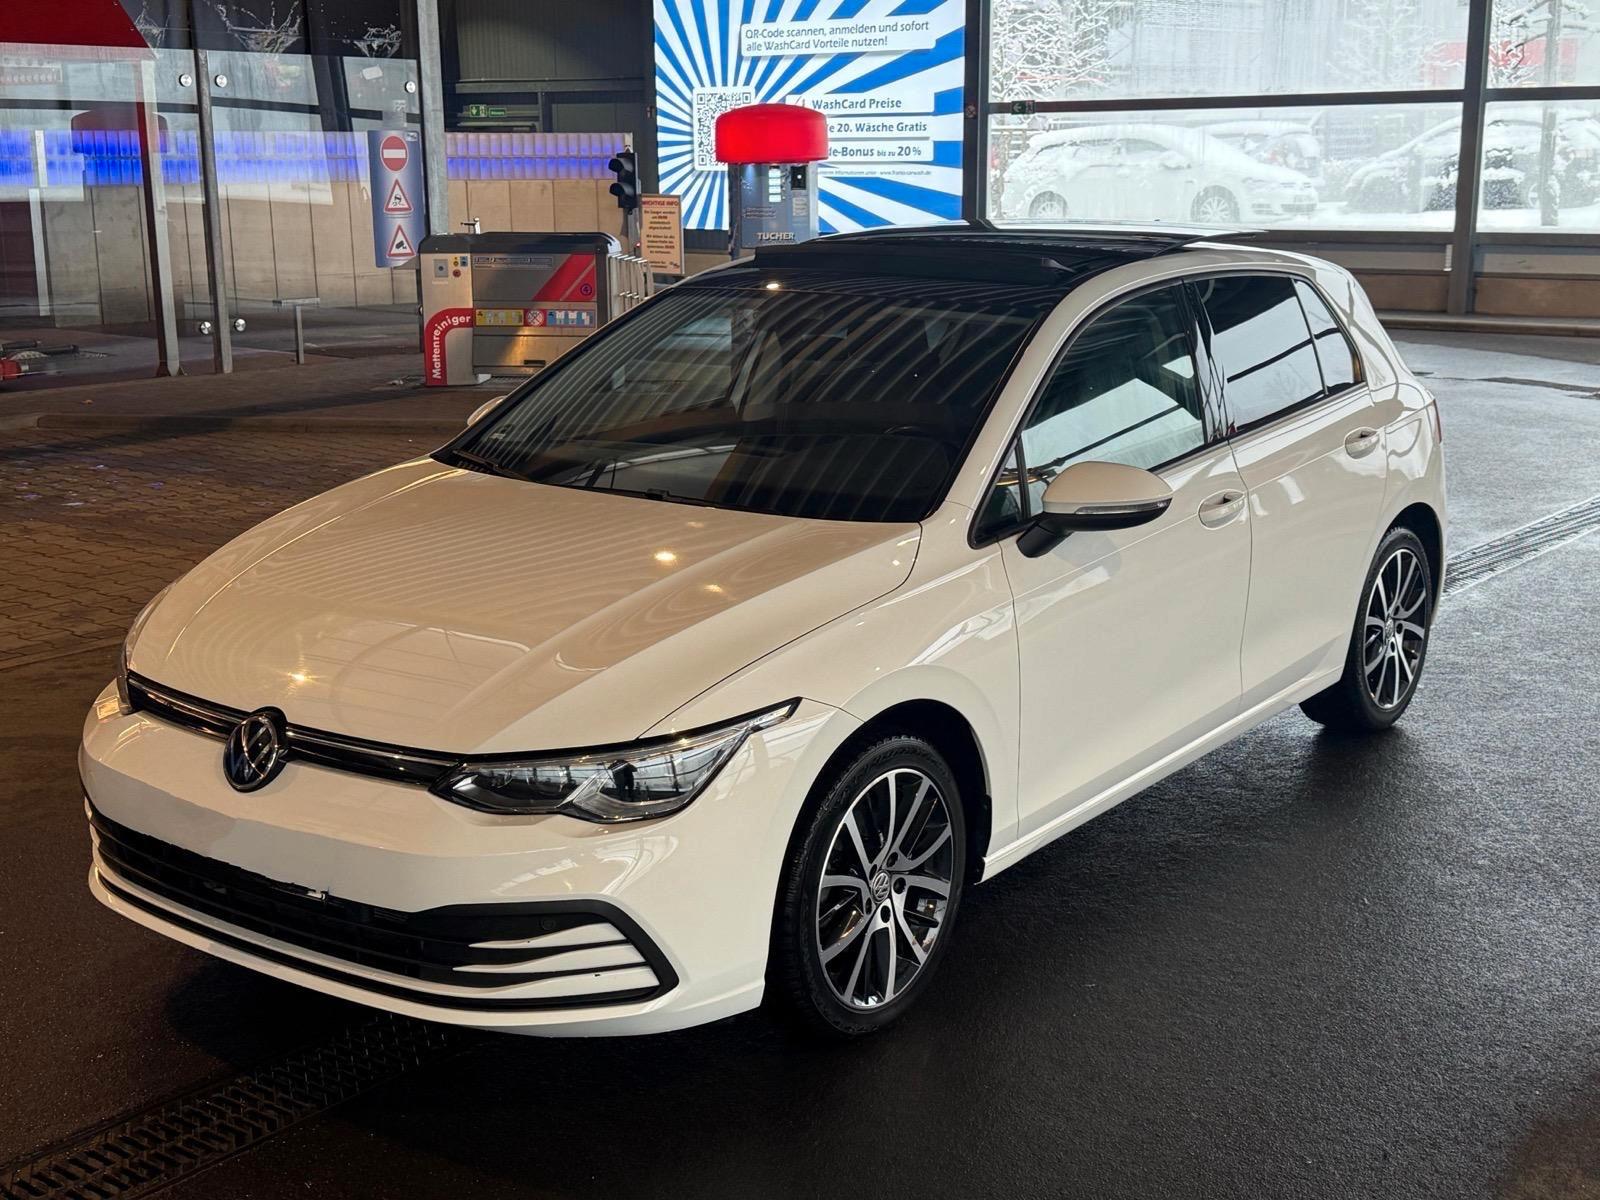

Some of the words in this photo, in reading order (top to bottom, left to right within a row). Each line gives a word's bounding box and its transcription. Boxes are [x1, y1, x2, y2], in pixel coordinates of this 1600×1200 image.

[745, 28, 784, 39] QR-Code
[786, 28, 826, 38] scannen,
[828, 24, 877, 35] anmelden
[878, 22, 898, 32] und
[899, 21, 929, 31] sofort
[746, 41, 762, 52] alle
[763, 39, 811, 51] WashCard
[812, 37, 849, 49] Vorteile
[851, 36, 888, 47] nutzen!
[812, 98, 867, 110] WashCard
[869, 97, 902, 109] Preise
[837, 123, 853, 133] 20.
[855, 122, 894, 133] Wäsche
[896, 121, 927, 132] Gratis
[757, 232, 795, 241] TUCHER
[432, 314, 472, 380] Mattenreiniger
